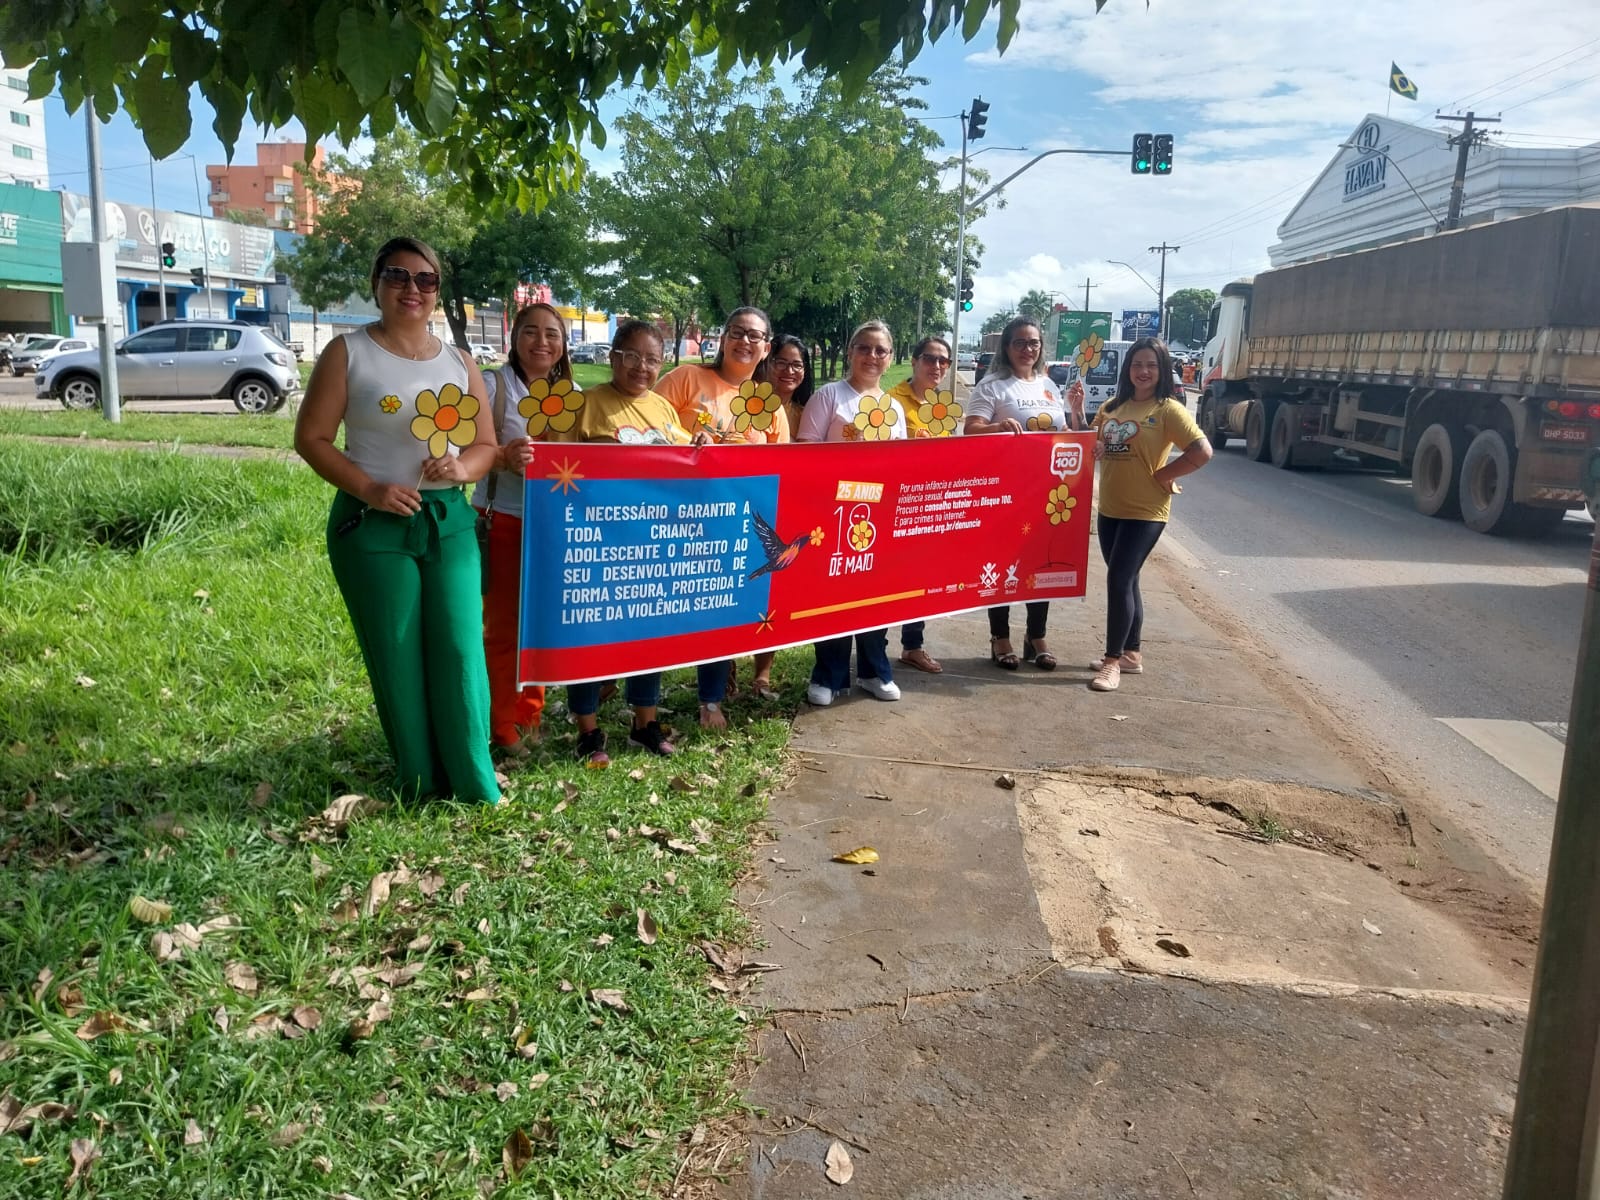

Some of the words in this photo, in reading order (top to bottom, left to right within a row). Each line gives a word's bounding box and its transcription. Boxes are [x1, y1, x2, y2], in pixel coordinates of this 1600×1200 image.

[1344, 156, 1387, 195] HAVAN
[1056, 457, 1077, 468] 100
[838, 484, 852, 499] 25
[853, 484, 882, 500] ANOS
[900, 484, 909, 493] Por
[912, 484, 924, 492] uma
[925, 481, 947, 490] infância
[565, 503, 574, 522] É
[585, 502, 668, 521] NECESSÁRIO
[678, 502, 735, 518] GARANTIR
[743, 501, 750, 514] A
[896, 506, 918, 515] Procure
[925, 502, 951, 512] conselho
[953, 499, 972, 509] tutelar
[981, 497, 1000, 506] Disque
[1001, 495, 1012, 504] 100.
[565, 527, 602, 543] TODA
[650, 523, 704, 540] CRIANÇA
[743, 519, 749, 533] E
[899, 517, 912, 528] para
[915, 514, 933, 524] crimes
[564, 544, 660, 563] ADOLESCENTE
[668, 543, 675, 558] O
[683, 540, 728, 557] DIREITO
[734, 538, 748, 552] AO
[563, 568, 590, 584] SEU
[603, 559, 723, 582] DESENVOLVIMENTO,
[733, 556, 747, 570] DE
[829, 557, 843, 576] DE
[845, 553, 874, 575] MAIO
[562, 587, 609, 604] FORMA
[614, 583, 667, 600] SEGURA,
[672, 575, 734, 595] PROTEGIDA
[738, 574, 745, 587] E
[562, 607, 602, 625] LIVRE
[606, 605, 623, 621] DA
[628, 598, 690, 618] VIOLÊNCIA
[693, 593, 738, 611] SEXUAL.
